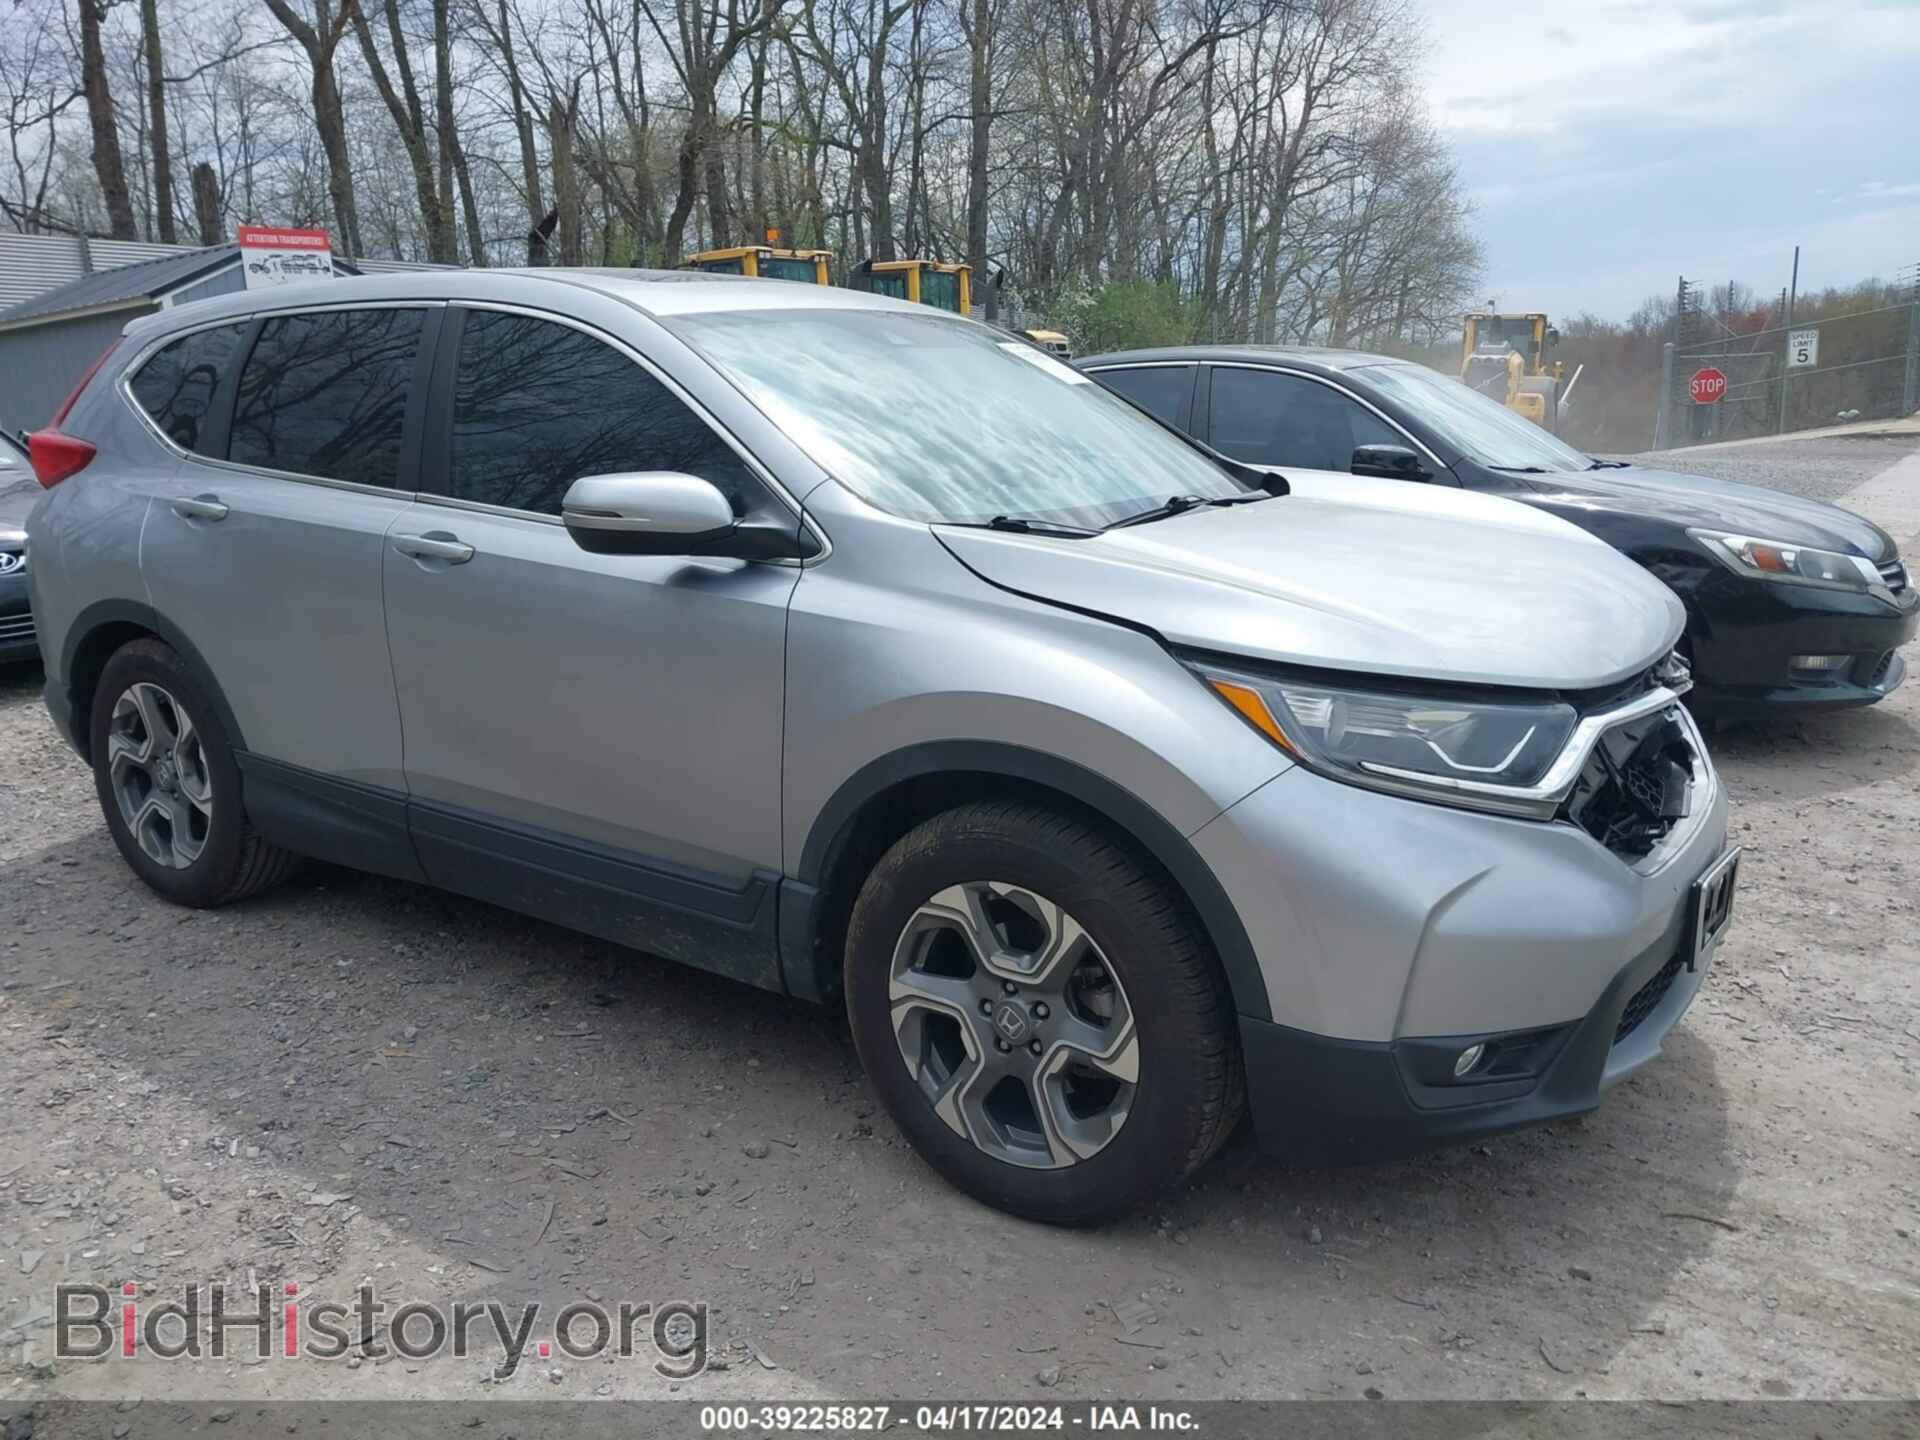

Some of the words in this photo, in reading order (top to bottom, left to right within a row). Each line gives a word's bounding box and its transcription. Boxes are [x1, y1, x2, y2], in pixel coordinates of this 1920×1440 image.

[1792, 339, 1813, 348] LIMIT
[1796, 348, 1809, 363] 5
[1691, 378, 1724, 394] STOP
